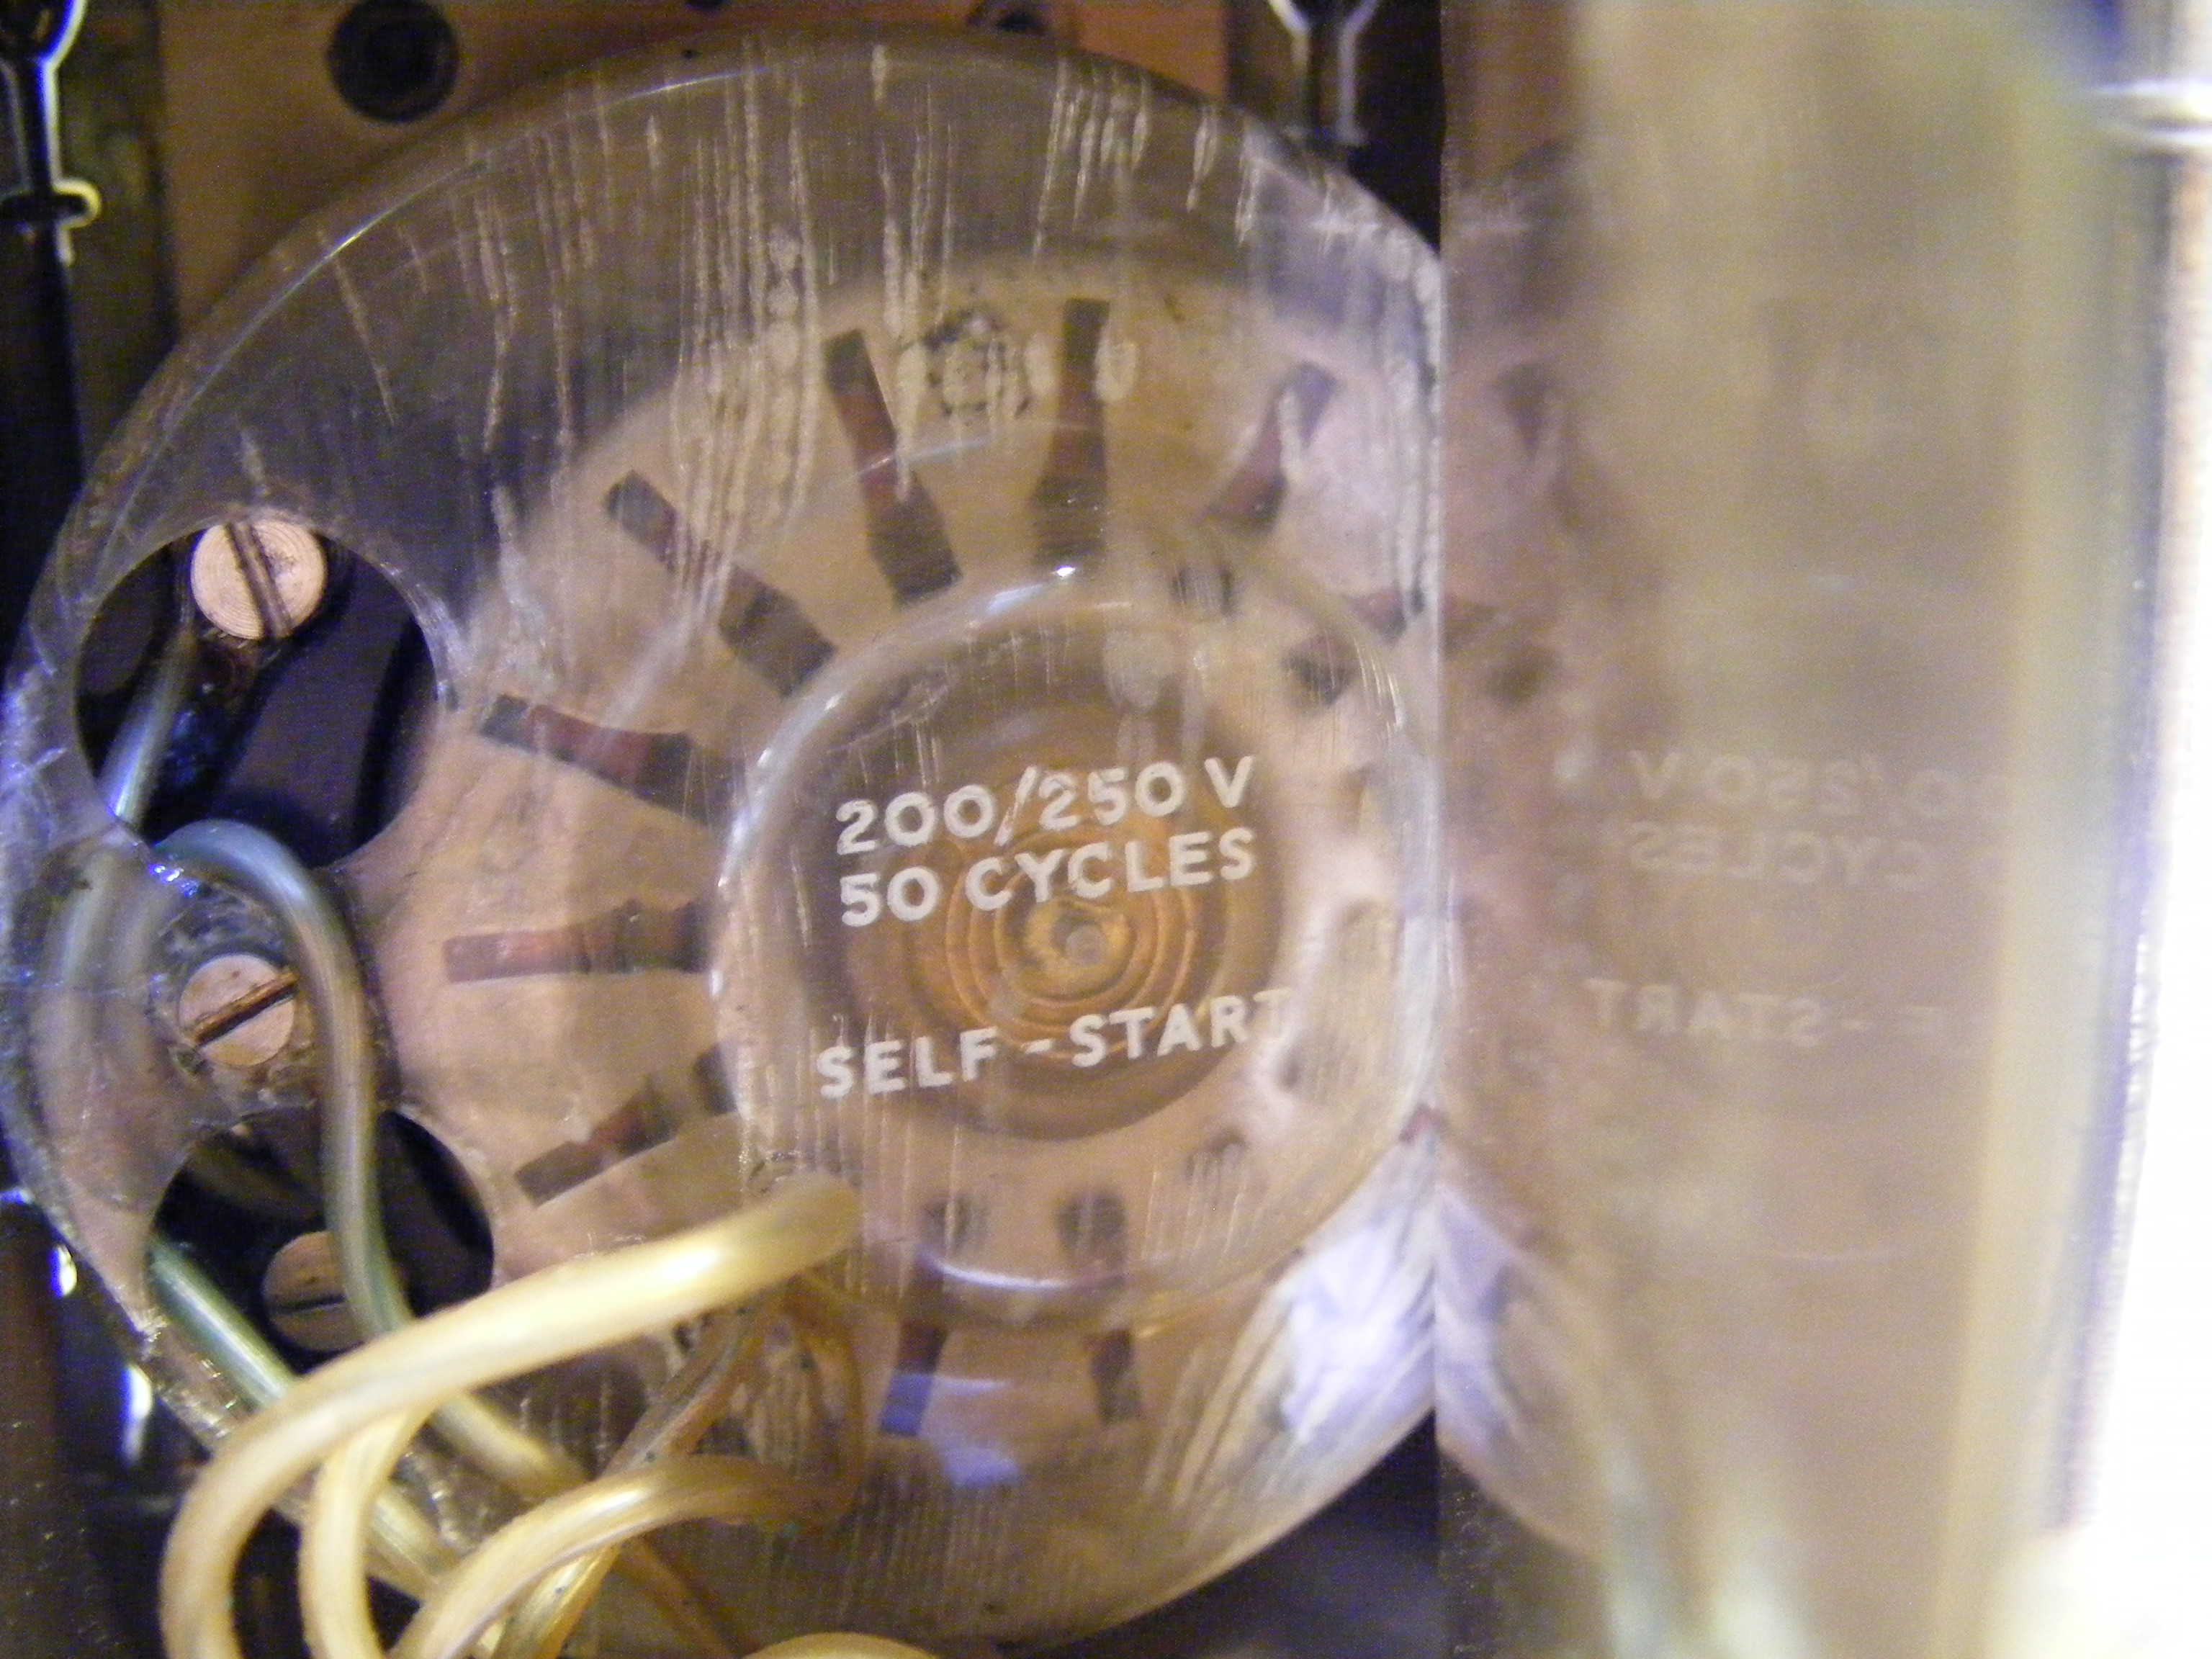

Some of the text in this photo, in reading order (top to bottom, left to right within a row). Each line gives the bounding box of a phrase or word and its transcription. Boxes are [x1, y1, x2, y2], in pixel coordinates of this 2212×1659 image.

[836, 755, 1255, 855] 200/250 V
[839, 827, 1256, 927] 50 CYCLES
